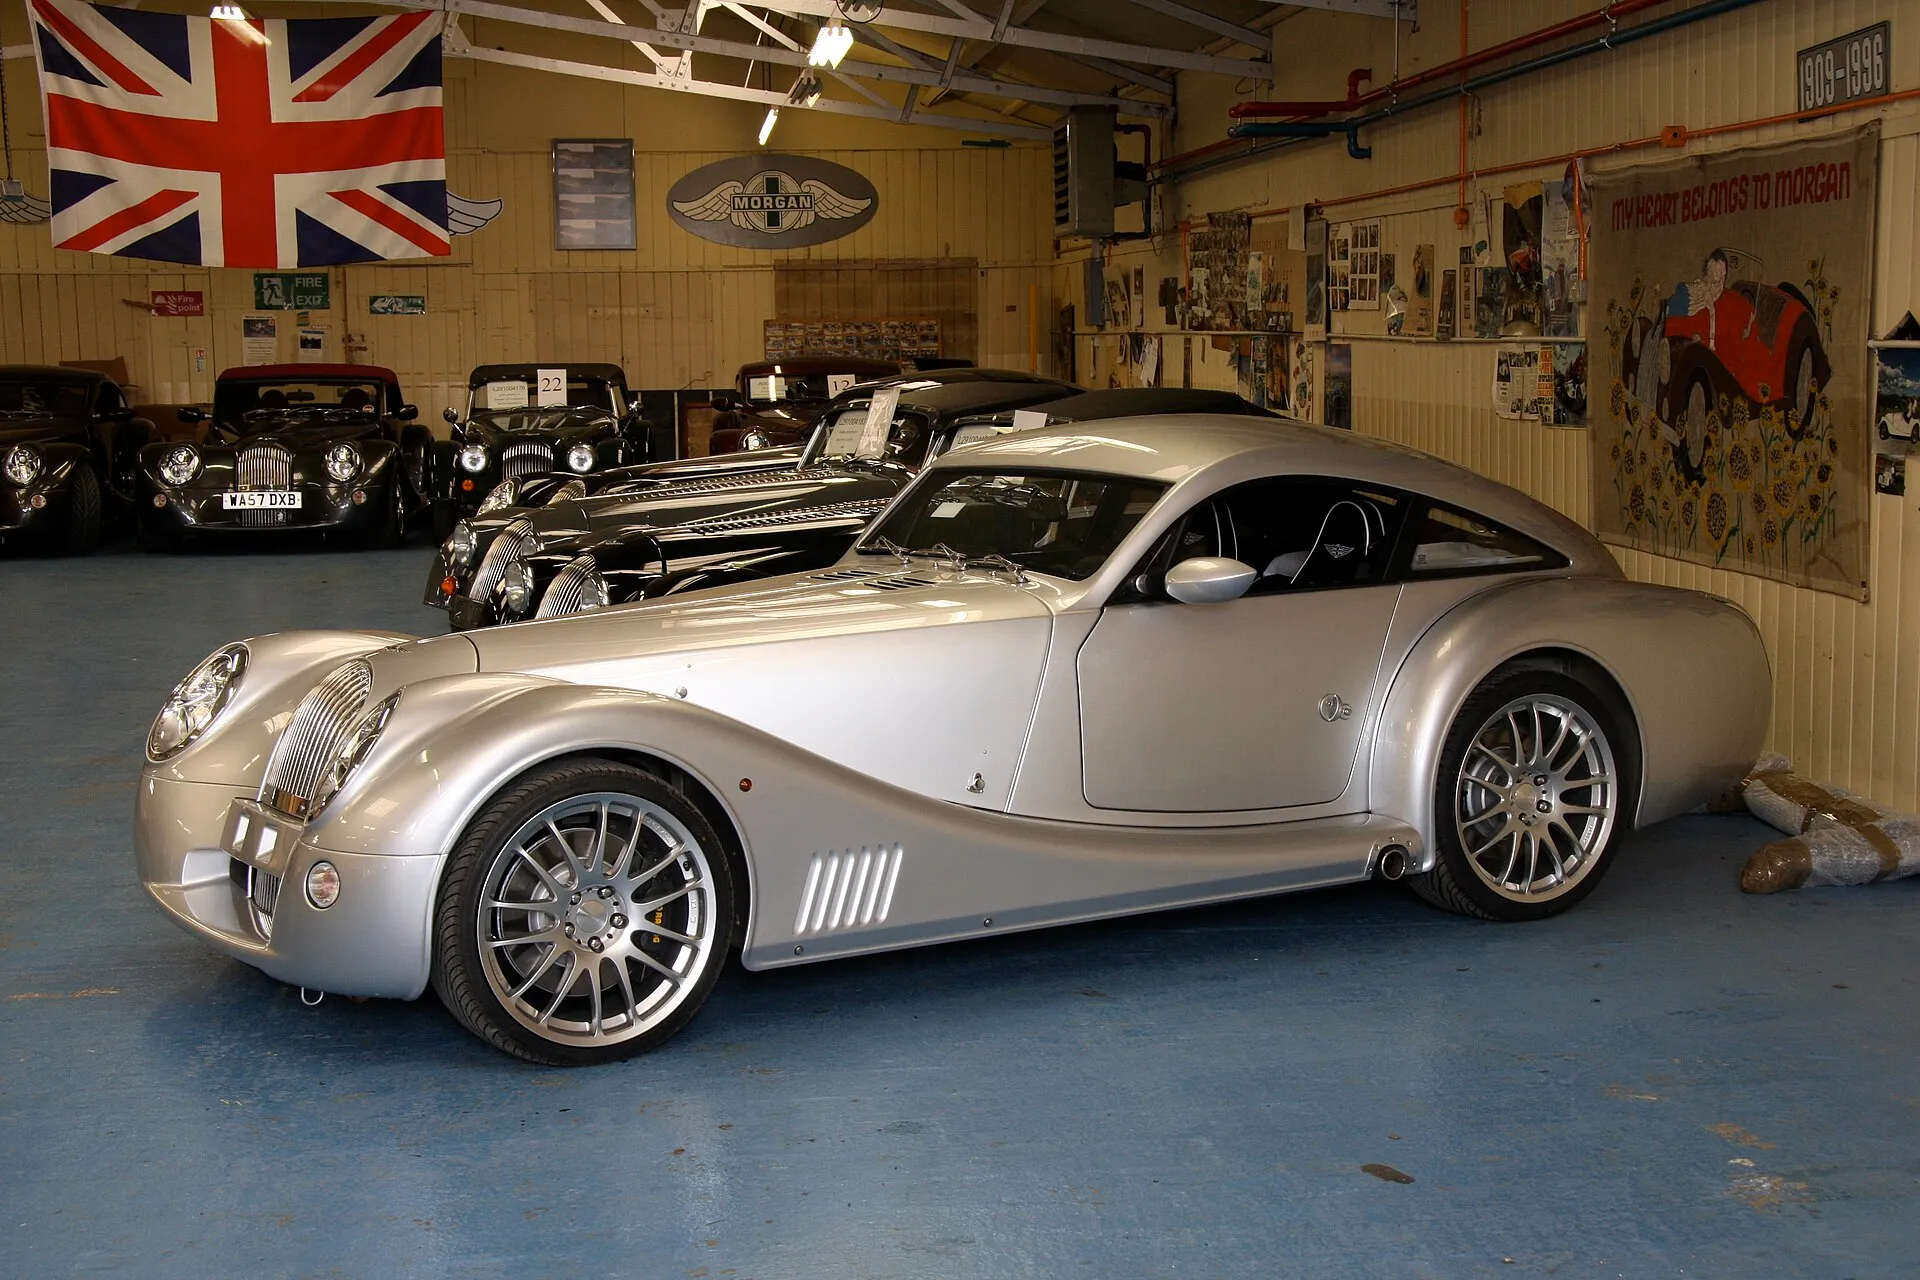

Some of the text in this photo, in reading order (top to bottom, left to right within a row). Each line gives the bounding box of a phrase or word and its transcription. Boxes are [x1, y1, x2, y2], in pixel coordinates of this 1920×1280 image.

[1800, 33, 1884, 111] 1909-1996
[734, 196, 812, 209] MORGAN
[1611, 198, 1633, 232] MY
[1636, 191, 1680, 228] HEART
[1681, 174, 1749, 223] BELONGS
[1752, 172, 1771, 210] TO
[1774, 161, 1850, 209] MORGAN
[295, 277, 322, 287] FIRE
[177, 295, 194, 303] Fire
[296, 295, 323, 305] EXIT
[177, 303, 201, 313] point
[541, 377, 562, 392] 22
[833, 380, 850, 391] 12
[229, 493, 296, 507] WA57 DXB
